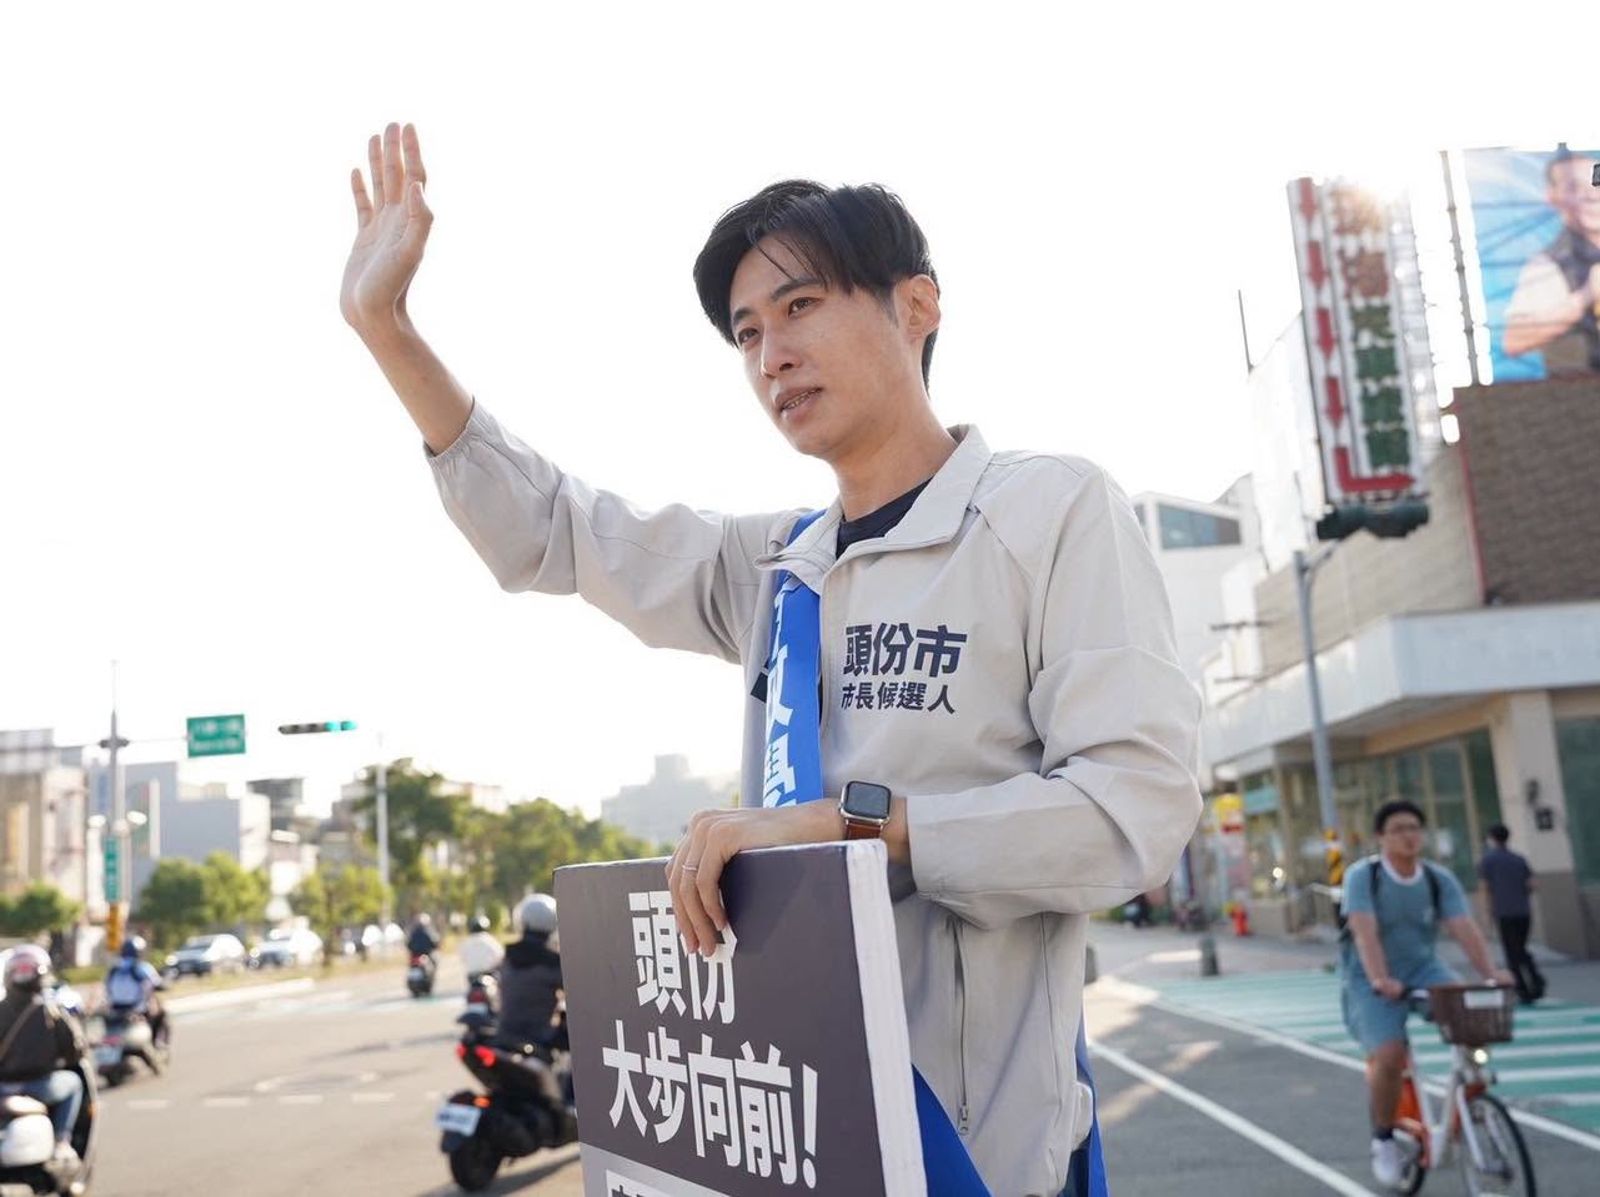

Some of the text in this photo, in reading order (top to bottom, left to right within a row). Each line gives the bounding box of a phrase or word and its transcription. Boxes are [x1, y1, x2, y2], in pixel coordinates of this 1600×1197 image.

[843, 622, 968, 678] 頭份市
[841, 681, 956, 715] 市長候選人
[602, 1018, 818, 1190] 大步向前!
